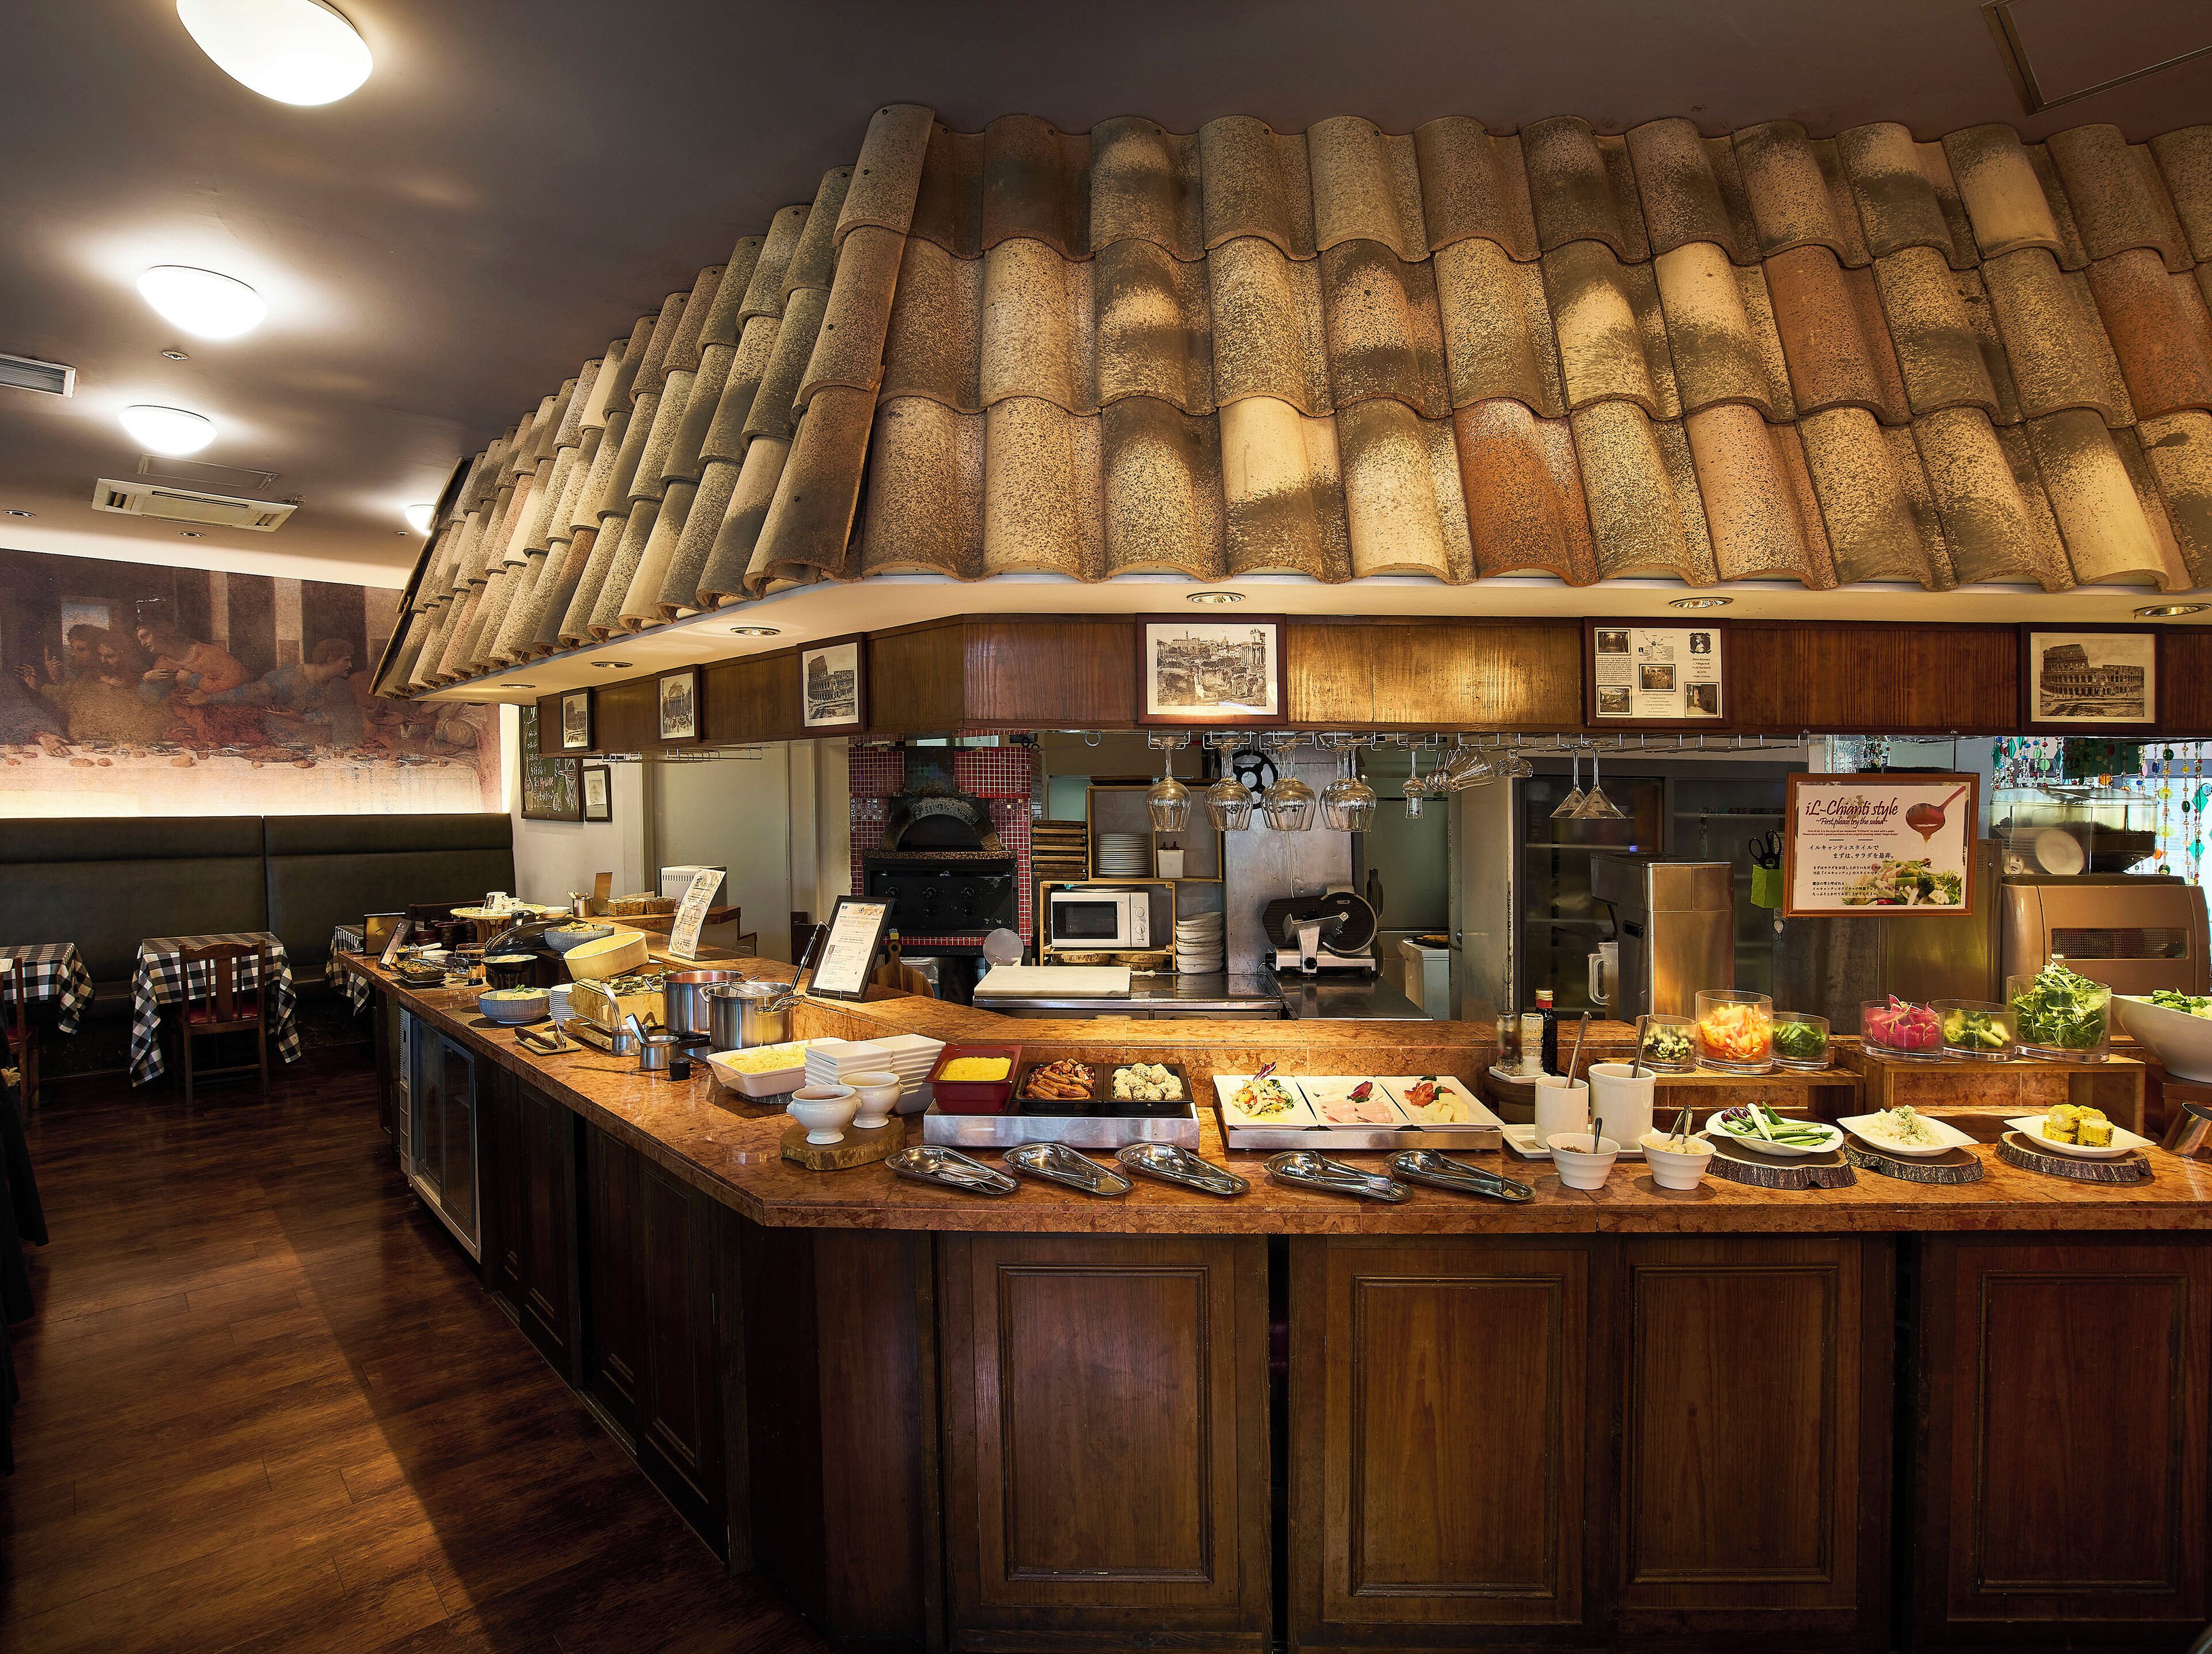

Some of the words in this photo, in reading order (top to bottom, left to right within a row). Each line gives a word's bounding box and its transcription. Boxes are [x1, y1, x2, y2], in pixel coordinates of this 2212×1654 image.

[1870, 797, 1898, 820] style
[1851, 817, 1859, 829] try
[1860, 816, 1869, 825] the
